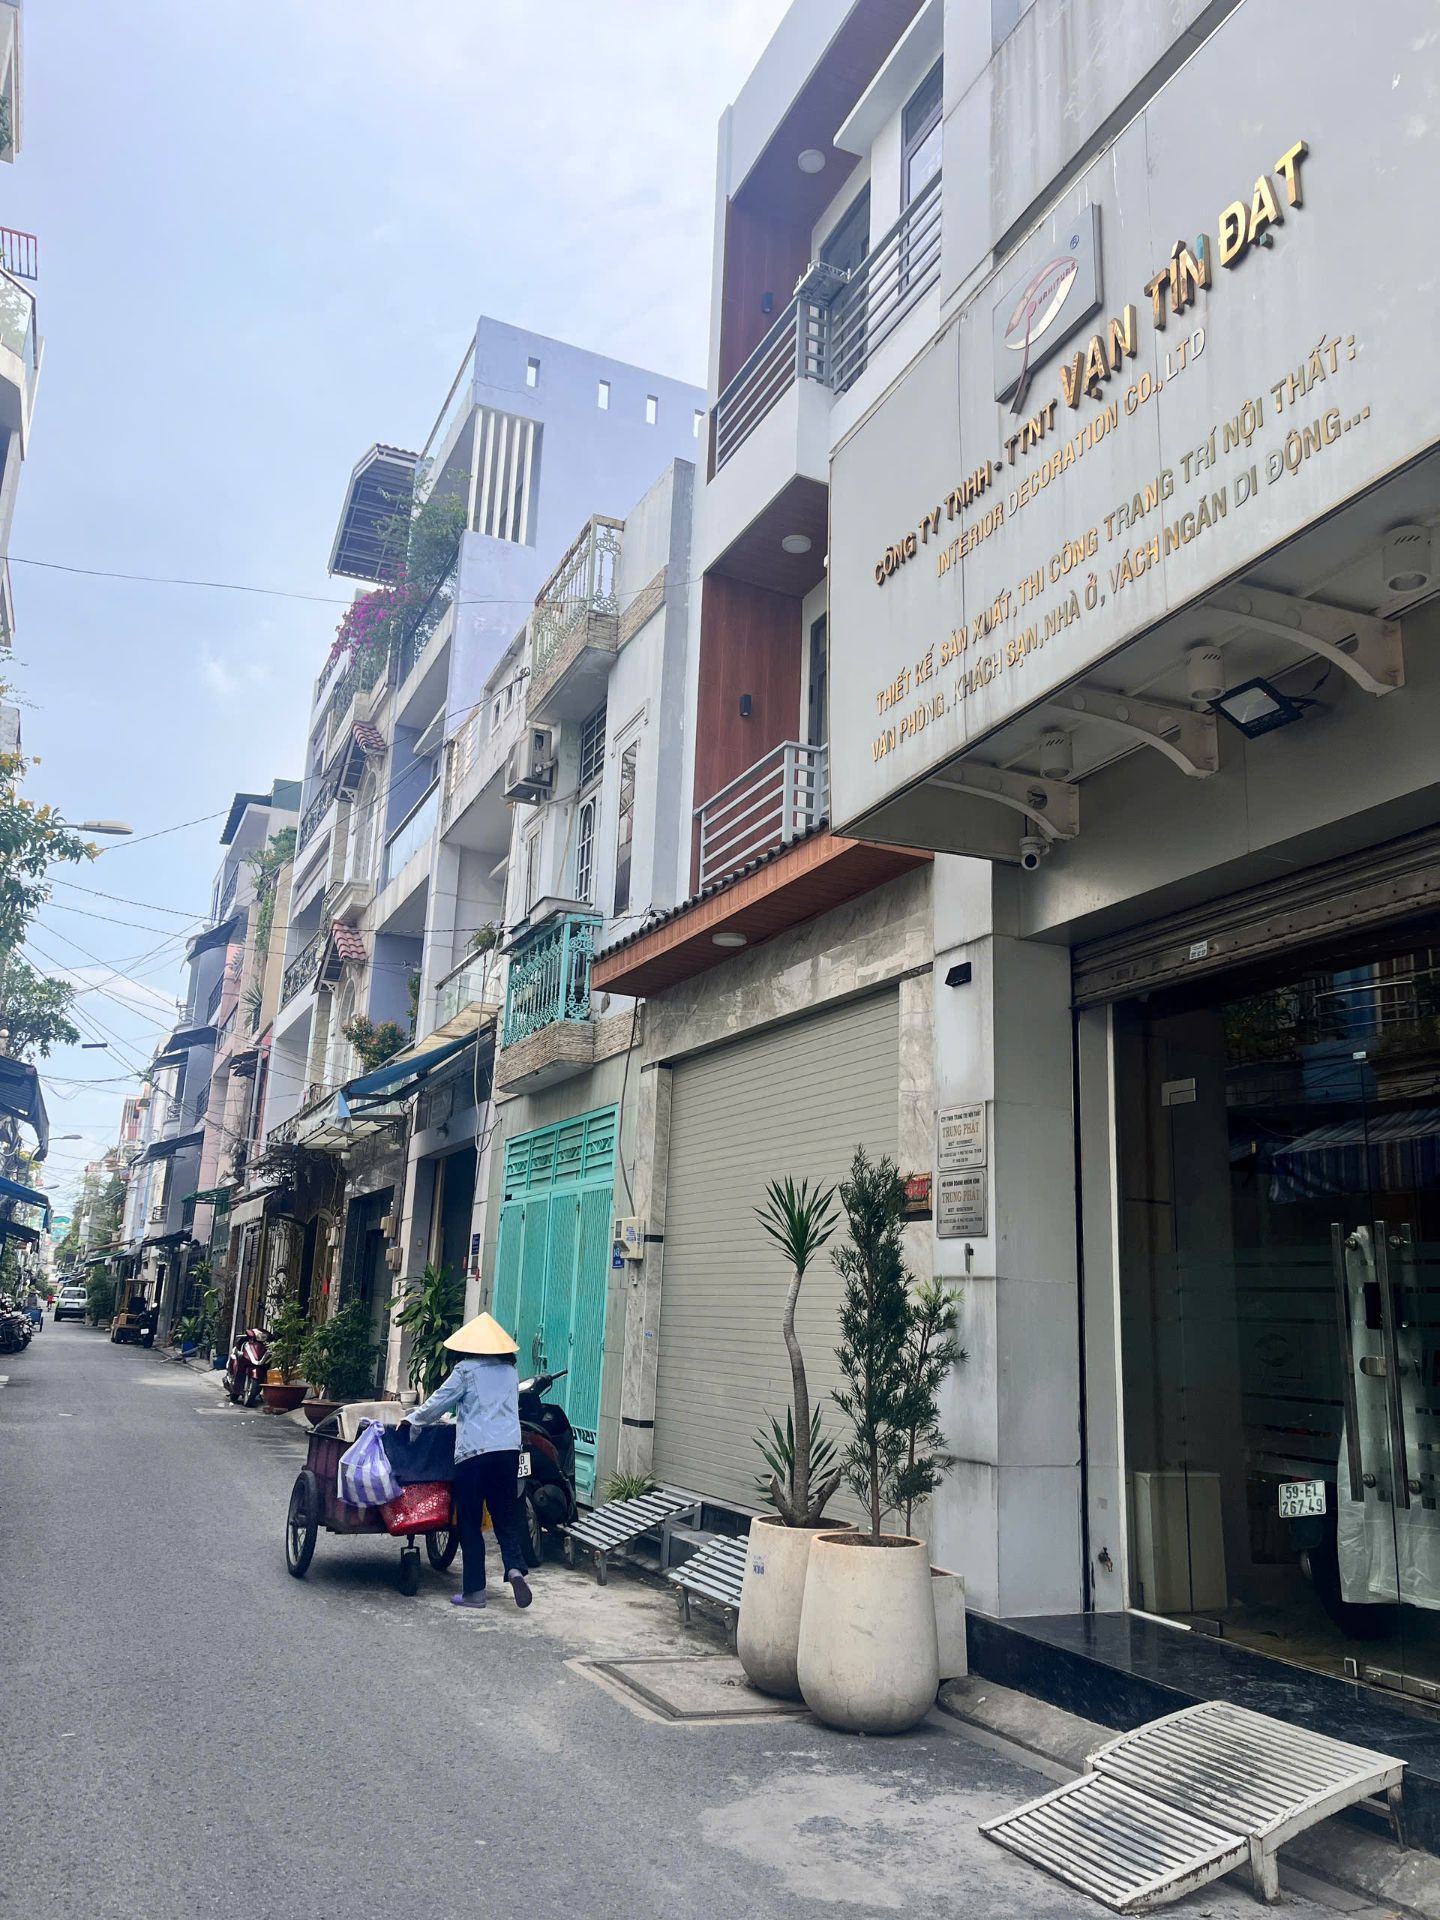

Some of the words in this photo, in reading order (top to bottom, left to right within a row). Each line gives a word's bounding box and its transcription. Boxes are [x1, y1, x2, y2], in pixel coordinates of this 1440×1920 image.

[874, 531, 917, 586] CÔNG
[918, 506, 941, 544] TY
[944, 460, 992, 520] TNHH
[1004, 398, 1057, 466] TTNT
[1059, 304, 1138, 409] VẠN
[1144, 233, 1212, 330] TÍN
[1218, 140, 1309, 271] ĐẠT
[936, 501, 1004, 578] INTERIOR
[1008, 400, 1118, 518] DECORATION
[876, 666, 911, 716] THIẾT
[939, 625, 968, 667] SẢN
[1018, 566, 1045, 607] THI
[1049, 527, 1099, 584] CÔNG
[1104, 468, 1174, 541] TRANG
[1180, 426, 1217, 483] TRÍ
[1223, 397, 1263, 453] NỘI
[953, 648, 1003, 705] KHÁCH
[1109, 534, 1160, 594] VÁCH
[1163, 486, 1227, 556] NGĂN
[1233, 464, 1258, 508] DI
[942, 1124, 962, 1138] TRUNG
[963, 1119, 980, 1135] PHÁT
[942, 1190, 962, 1203] TRUNG
[963, 1187, 980, 1202] PHÁT
[1282, 1498, 1323, 1516] 267.49
[1285, 1483, 1317, 1500] 59-E1
